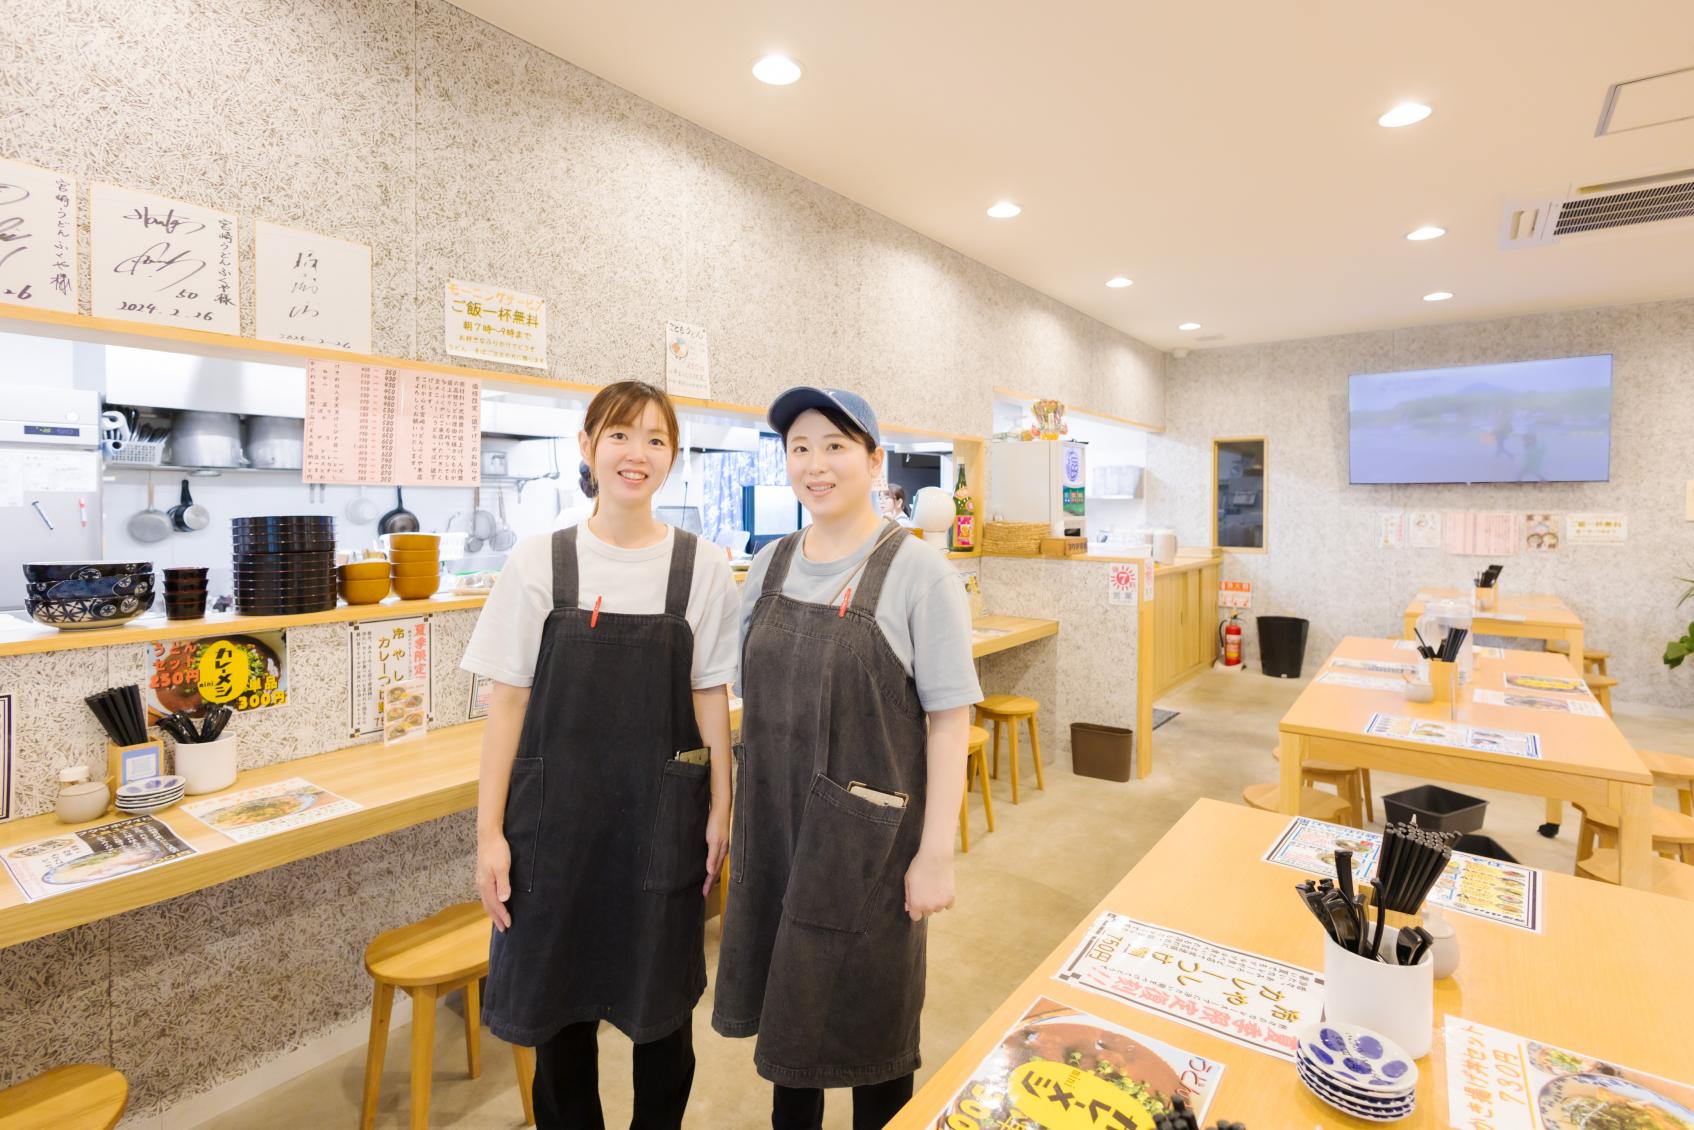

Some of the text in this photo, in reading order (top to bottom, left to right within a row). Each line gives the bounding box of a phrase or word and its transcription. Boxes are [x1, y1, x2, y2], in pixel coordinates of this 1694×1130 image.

[452, 299, 539, 329] ご飯一杯無料
[153, 642, 197, 657] うどん
[153, 657, 196, 672] セット
[149, 669, 200, 689] 250円
[249, 675, 278, 692] 単品
[238, 691, 285, 711] 300円
[1088, 933, 1122, 963] 750円
